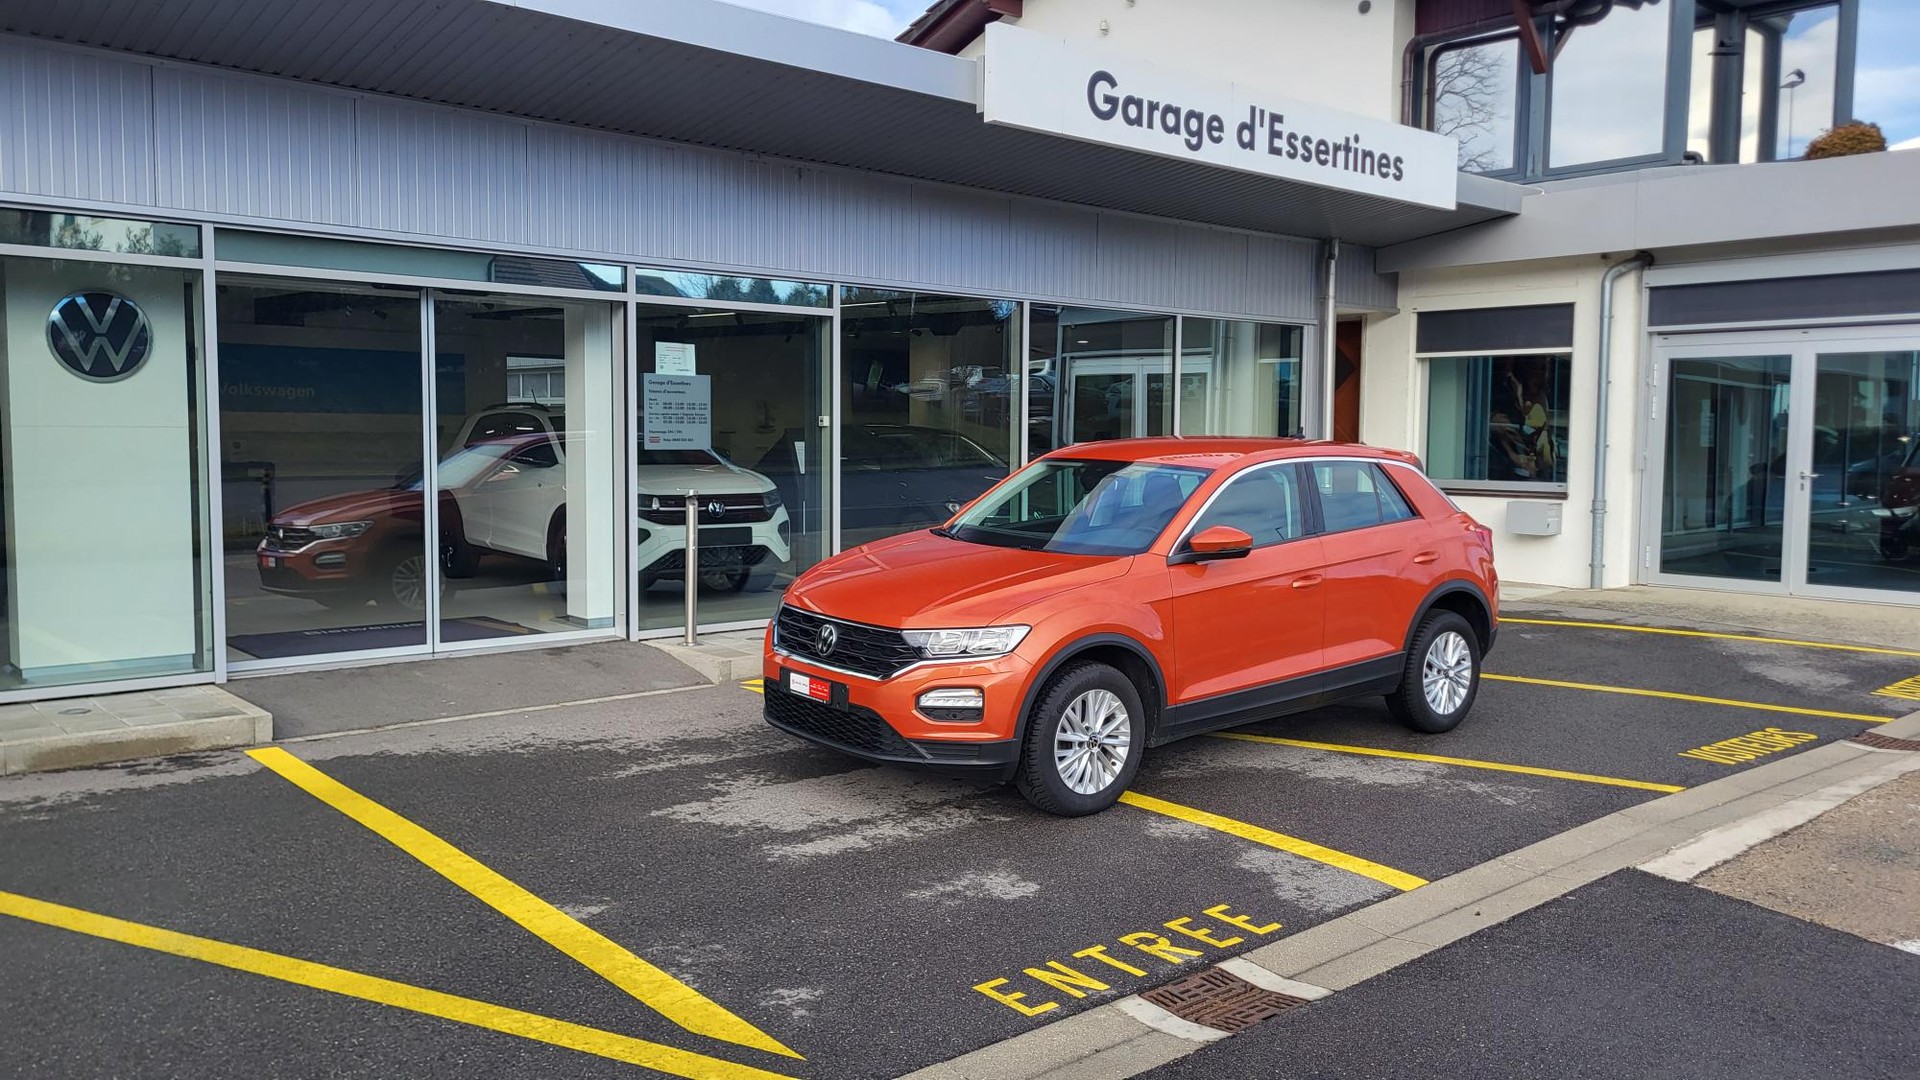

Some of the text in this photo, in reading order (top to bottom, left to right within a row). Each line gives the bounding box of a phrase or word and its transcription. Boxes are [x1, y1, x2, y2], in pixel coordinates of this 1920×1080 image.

[1087, 69, 1404, 182] Garage d'Essertines
[1677, 727, 1819, 765] VISITEURS
[971, 903, 1284, 1018] ENTREE
